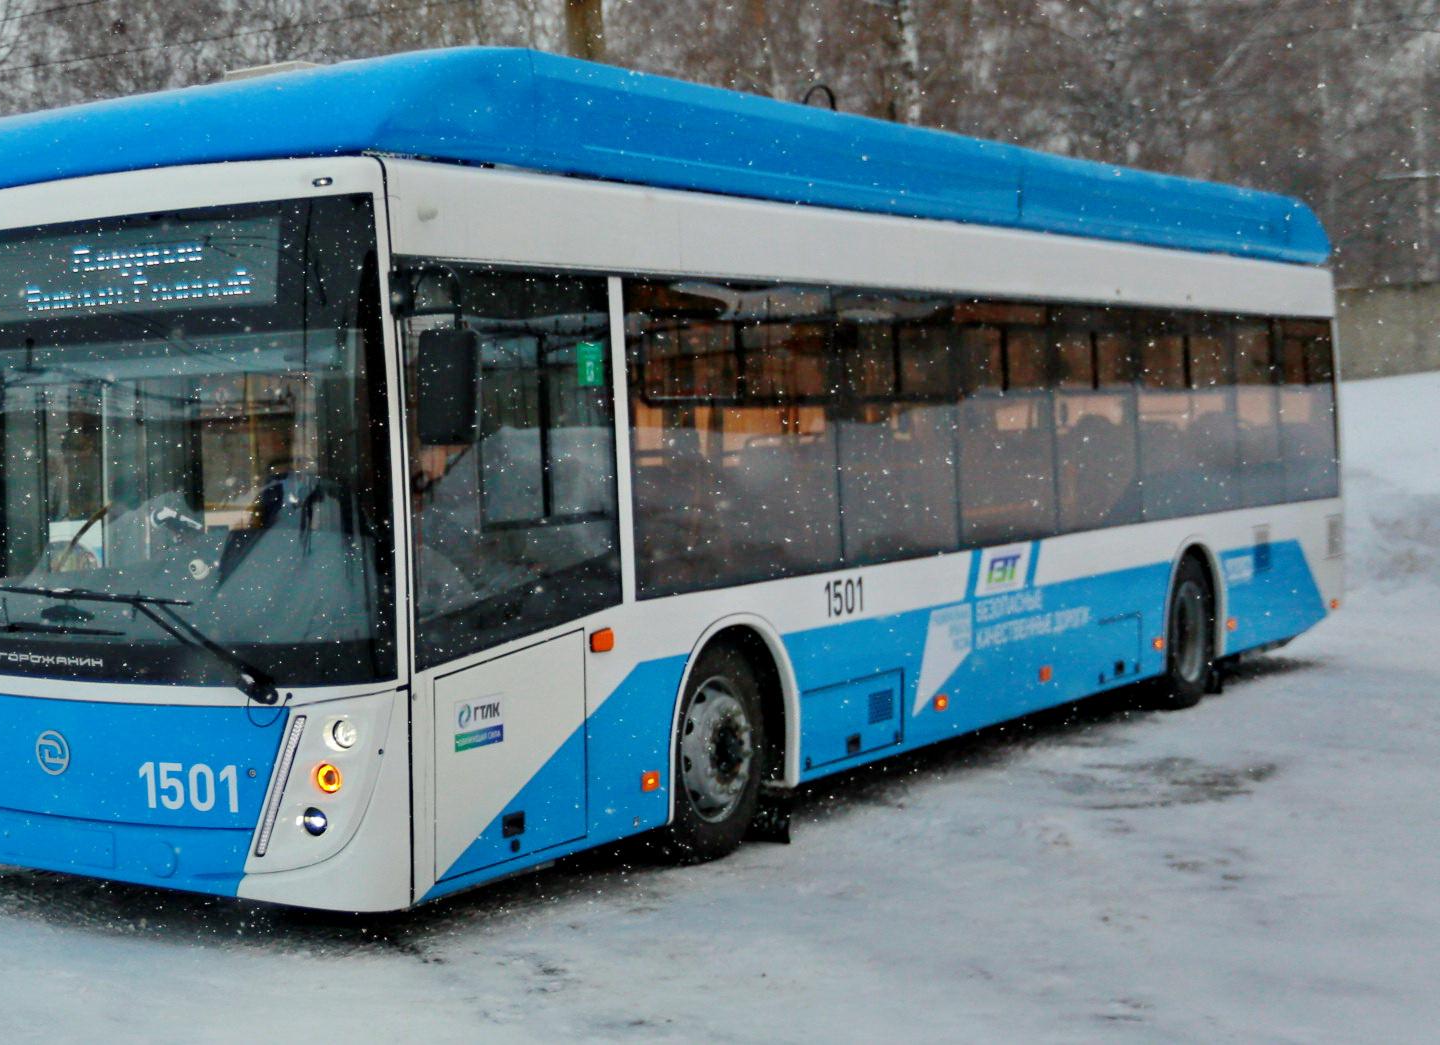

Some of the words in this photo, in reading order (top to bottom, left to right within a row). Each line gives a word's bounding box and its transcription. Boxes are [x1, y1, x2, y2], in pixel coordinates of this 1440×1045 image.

[824, 576, 864, 618] 1501
[473, 702, 500, 721] ГТЛК
[139, 761, 239, 813] 1501
